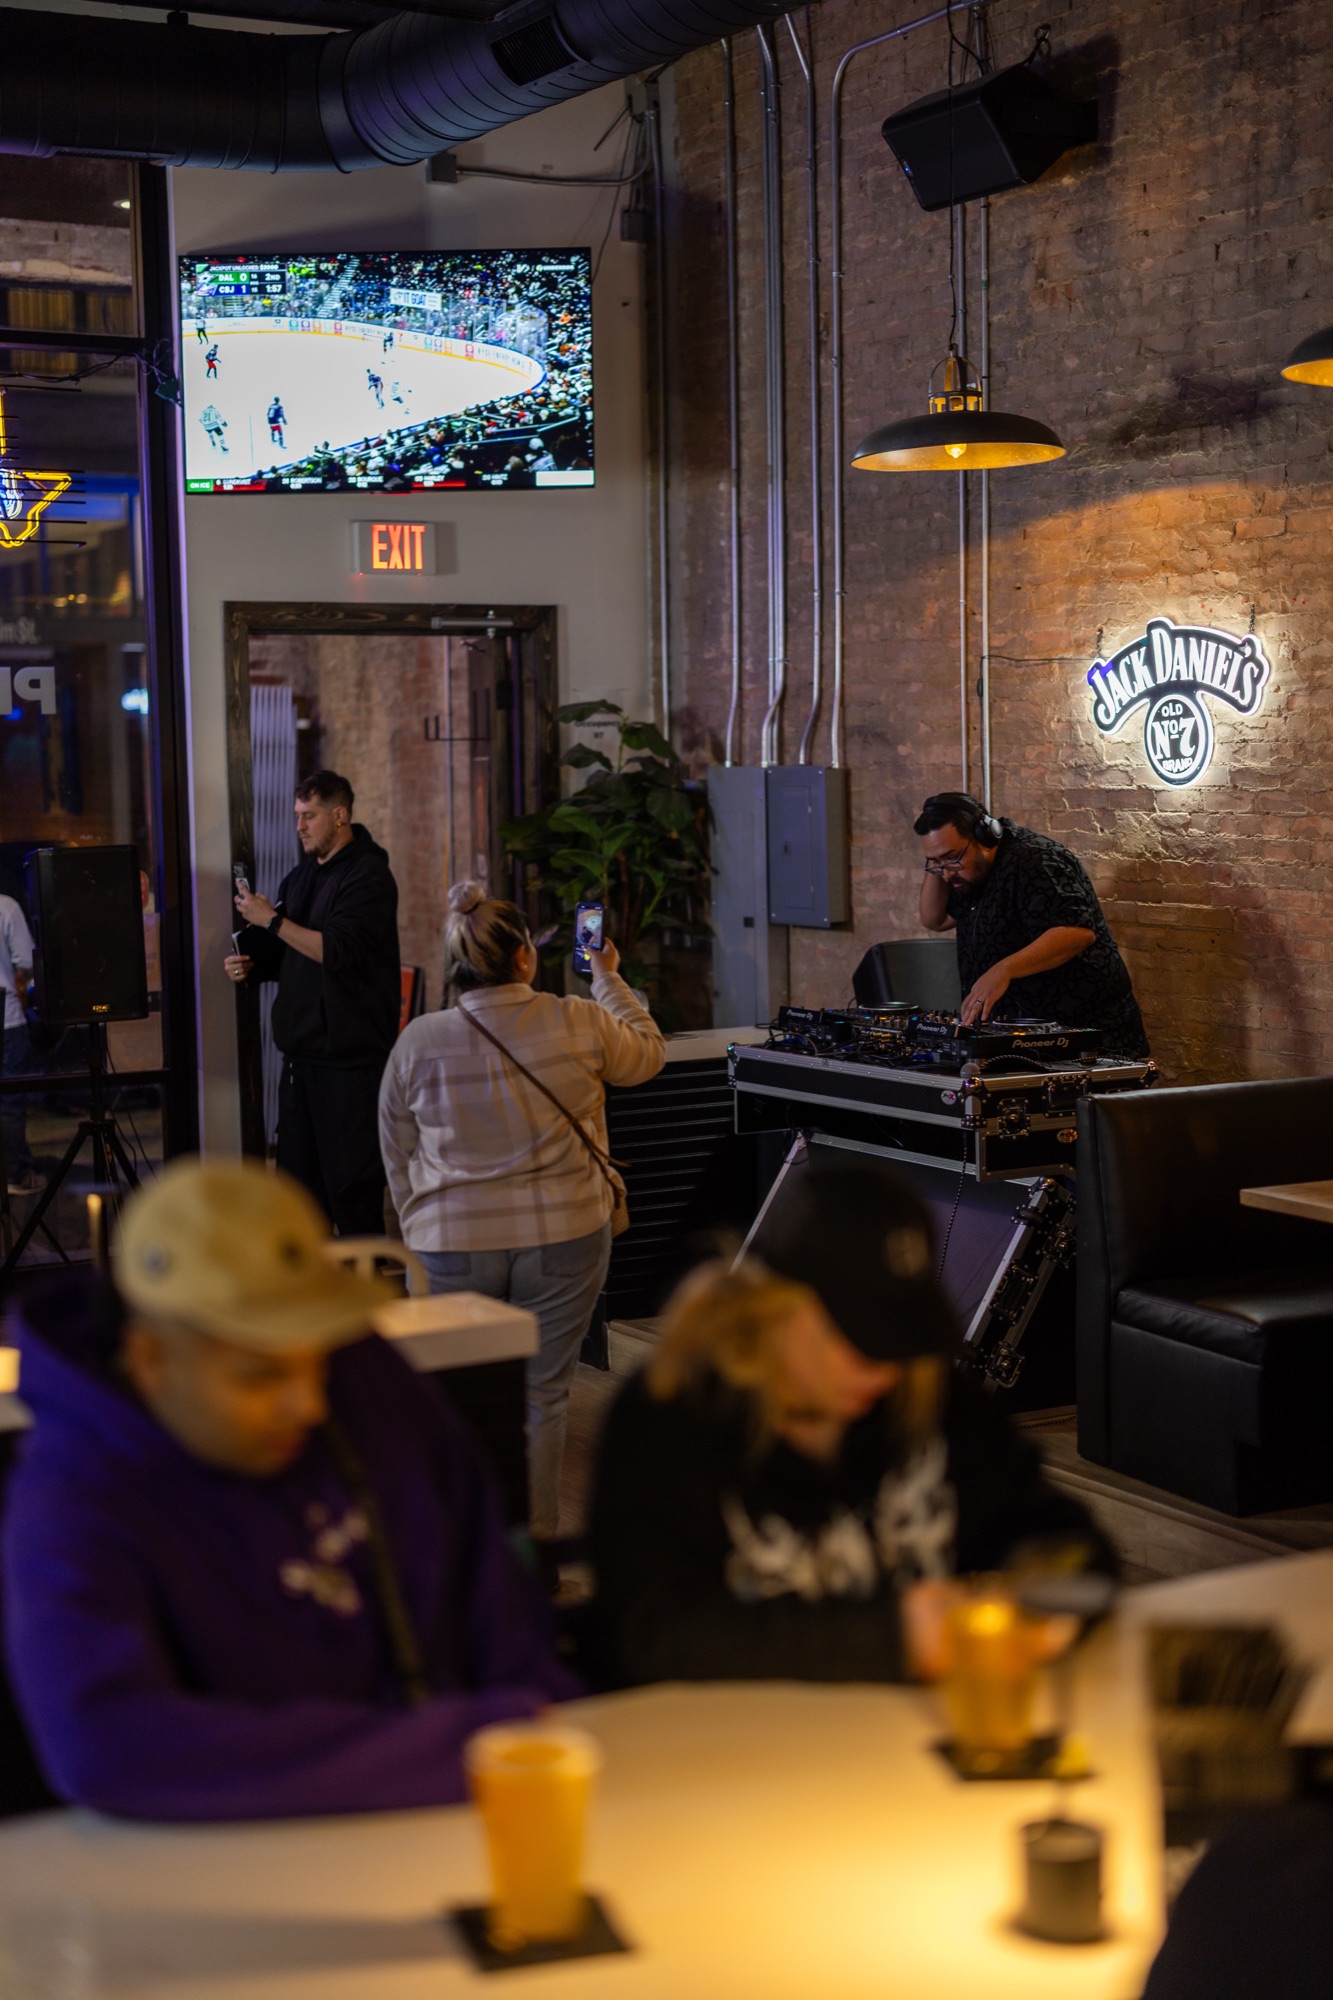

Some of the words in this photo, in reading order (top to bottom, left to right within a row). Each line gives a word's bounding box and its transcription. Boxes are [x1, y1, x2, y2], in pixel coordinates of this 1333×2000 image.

[218, 274, 234, 282] DAL
[240, 273, 247, 282] 0
[265, 273, 281, 281] 2ND
[218, 285, 235, 293] CBJ
[241, 285, 247, 293] 1
[265, 284, 283, 293] 1:57
[372, 524, 426, 569] EXIT
[1091, 646, 1155, 725] JACK
[1151, 628, 1259, 706] DANIEL'S
[1161, 703, 1183, 717] OLD
[1162, 758, 1193, 773] BRAND
[786, 1009, 807, 1018] Pioneer
[916, 1024, 940, 1033] Pioneer
[1012, 1038, 1056, 1049] Pioneer
